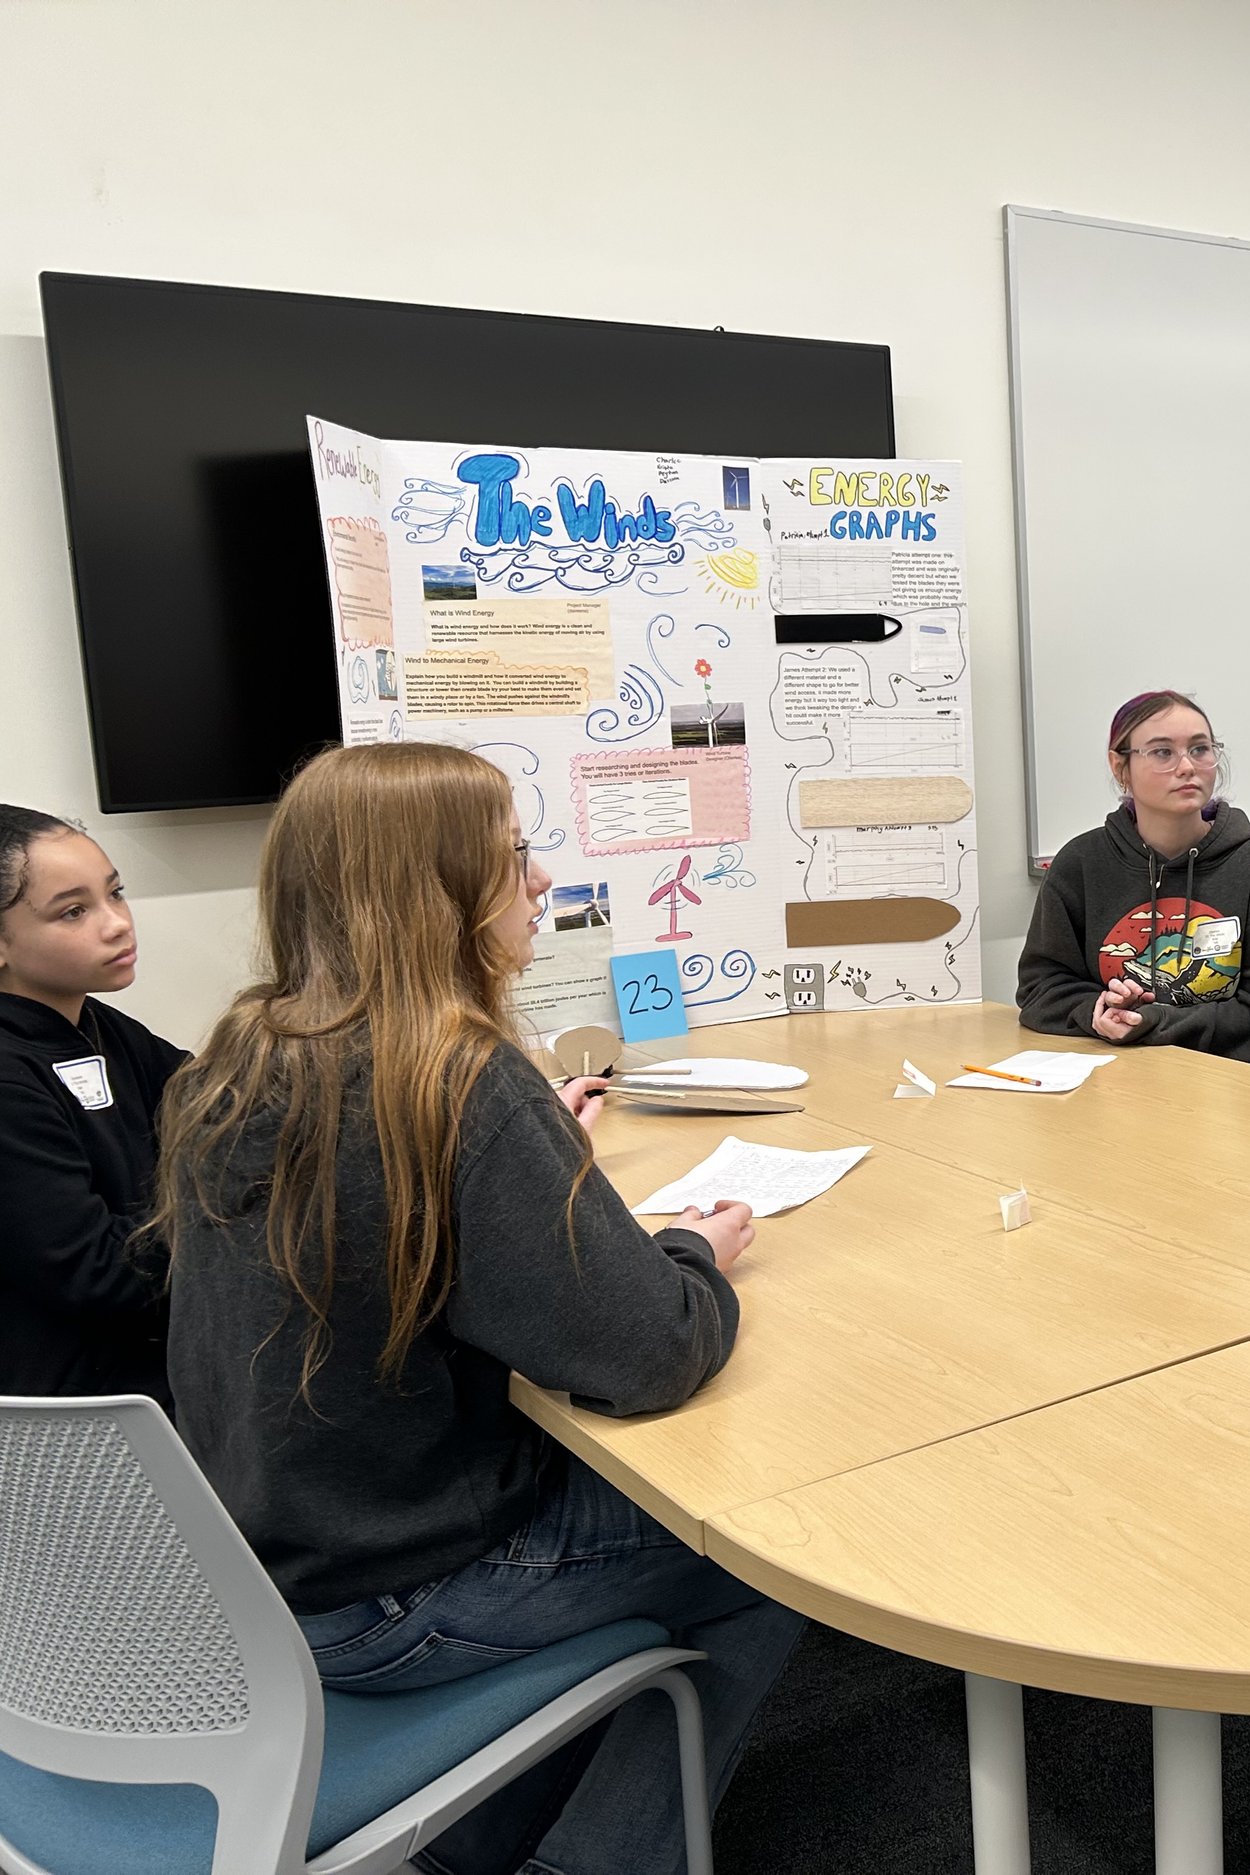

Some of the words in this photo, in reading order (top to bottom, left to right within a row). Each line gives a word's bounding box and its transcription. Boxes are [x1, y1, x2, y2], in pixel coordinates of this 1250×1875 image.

[315, 421, 357, 480] Renewable
[357, 446, 380, 498] Energy
[457, 454, 553, 547] The
[556, 480, 676, 549] Winds
[809, 467, 930, 507] ENERGY
[830, 510, 937, 541] GRAPHS
[595, 763, 629, 771] researching
[642, 761, 669, 769] designing
[622, 973, 673, 1015] 23
